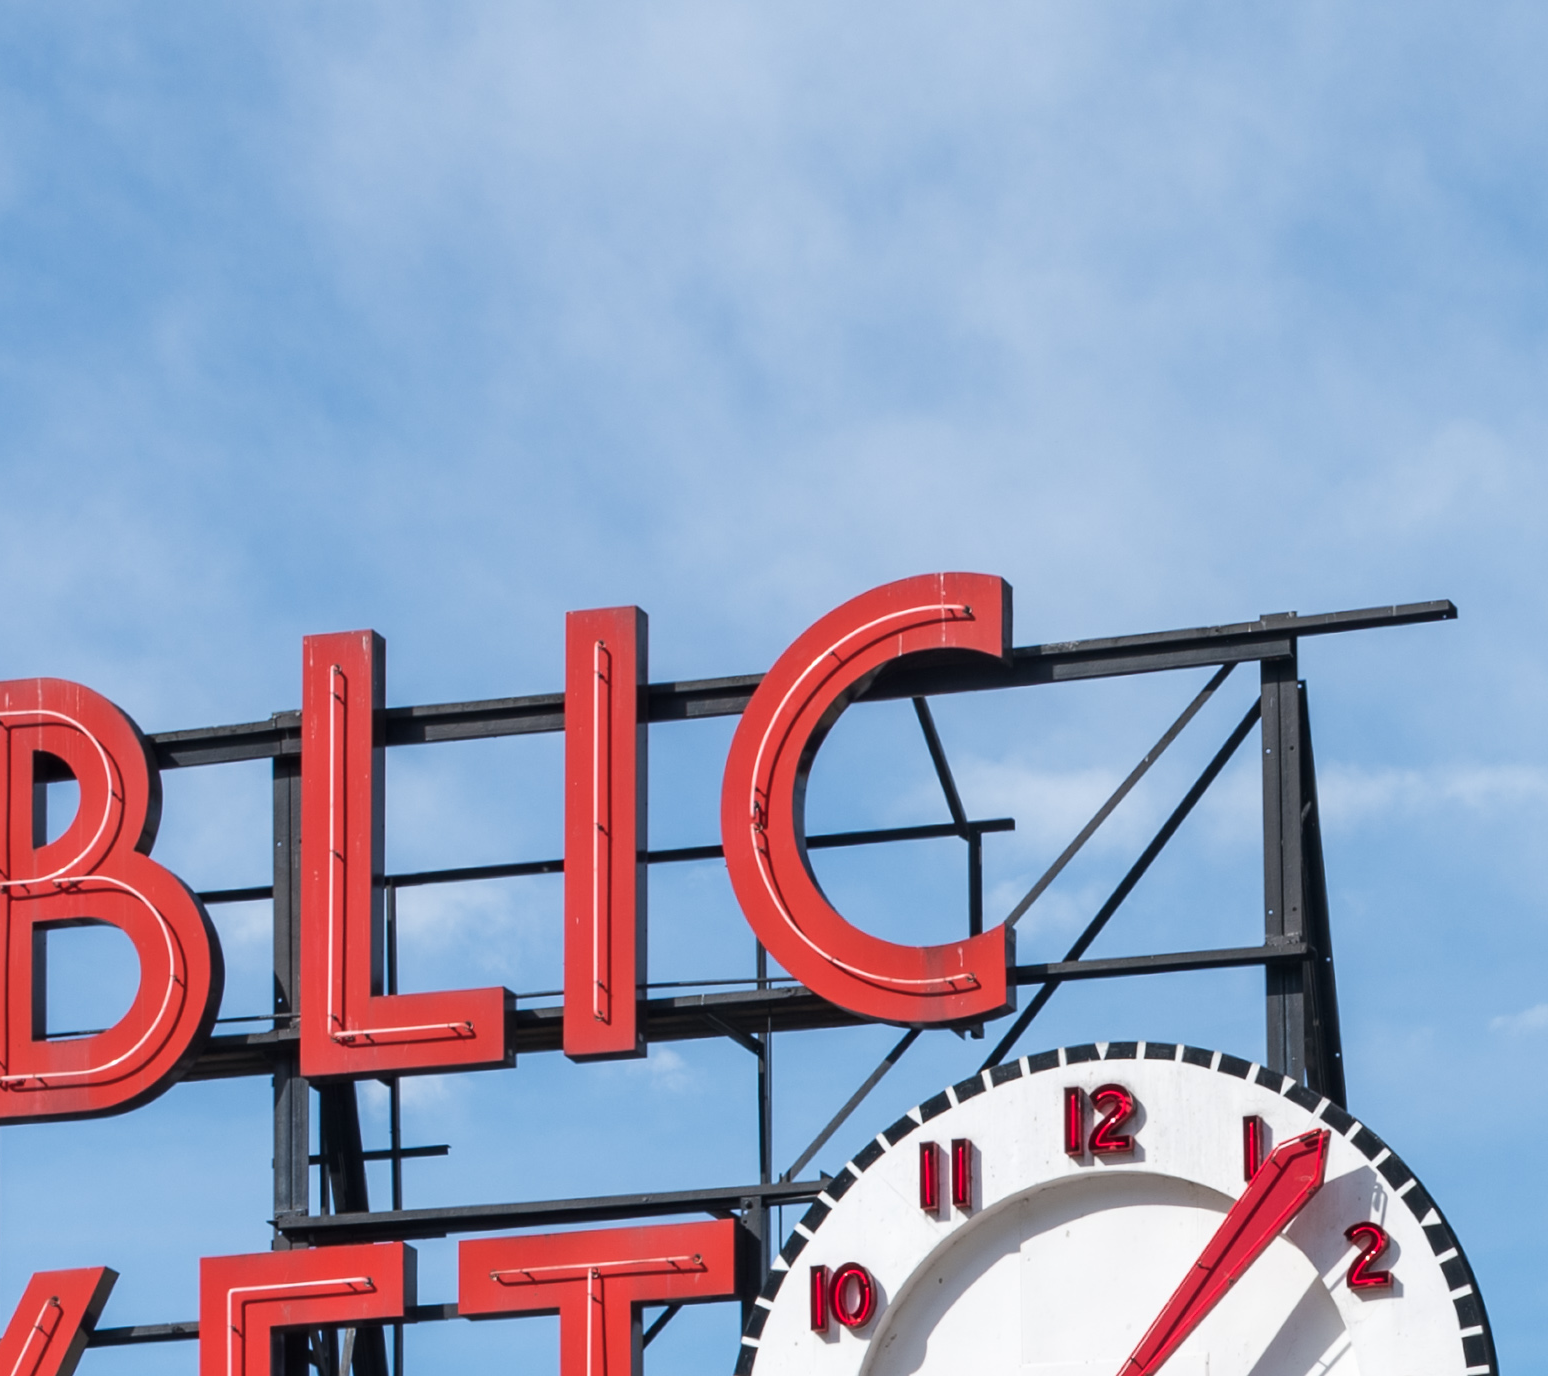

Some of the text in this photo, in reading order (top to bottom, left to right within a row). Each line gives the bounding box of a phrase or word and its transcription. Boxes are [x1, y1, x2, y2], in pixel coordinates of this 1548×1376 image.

[1063, 1083, 1138, 1157] 12
[920, 1139, 972, 1210] 11
[1345, 1221, 1393, 1290] 2
[810, 1262, 876, 1333] 10
